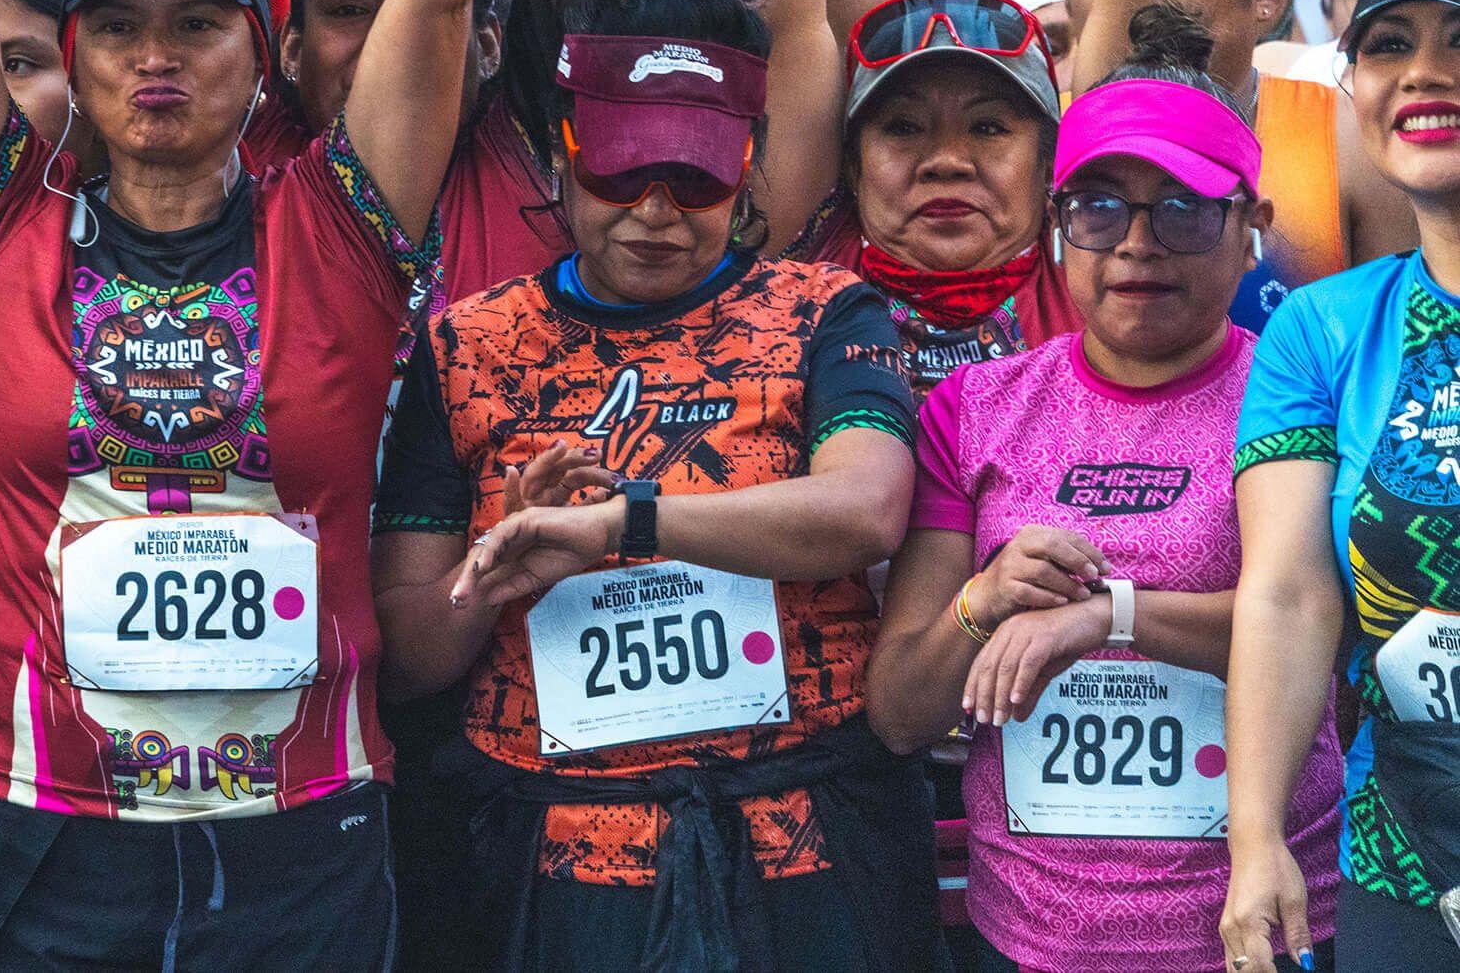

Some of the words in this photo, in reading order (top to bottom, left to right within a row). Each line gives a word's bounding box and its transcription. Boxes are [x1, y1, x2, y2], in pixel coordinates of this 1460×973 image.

[662, 43, 702, 56] MEDIO
[124, 338, 204, 362] MÉXICO
[917, 340, 983, 368] MÉXICO
[125, 370, 205, 388] IMPARABLE
[160, 388, 172, 400] DE
[173, 388, 201, 400] TIERRA
[659, 401, 732, 424] BLACK
[1421, 424, 1458, 441] MEDIO
[1070, 489, 1140, 506] RUN
[1142, 489, 1176, 506] IN
[147, 528, 182, 541] MÉXICO
[183, 529, 235, 540] IMPARABLE
[134, 540, 179, 556] MEDIO
[182, 538, 249, 555] MARATÓN
[602, 580, 637, 594] MÉXICO
[638, 571, 690, 588] IMPARABLE
[591, 590, 636, 611] MEDIO
[638, 579, 705, 604] MARATÓN
[115, 568, 267, 642] 2628
[579, 609, 730, 699] 2550
[1070, 672, 1102, 684] MÉXICO
[1104, 673, 1156, 685] IMPARABLE
[1059, 682, 1099, 698] MEDIO
[1041, 712, 1184, 787] 2829
